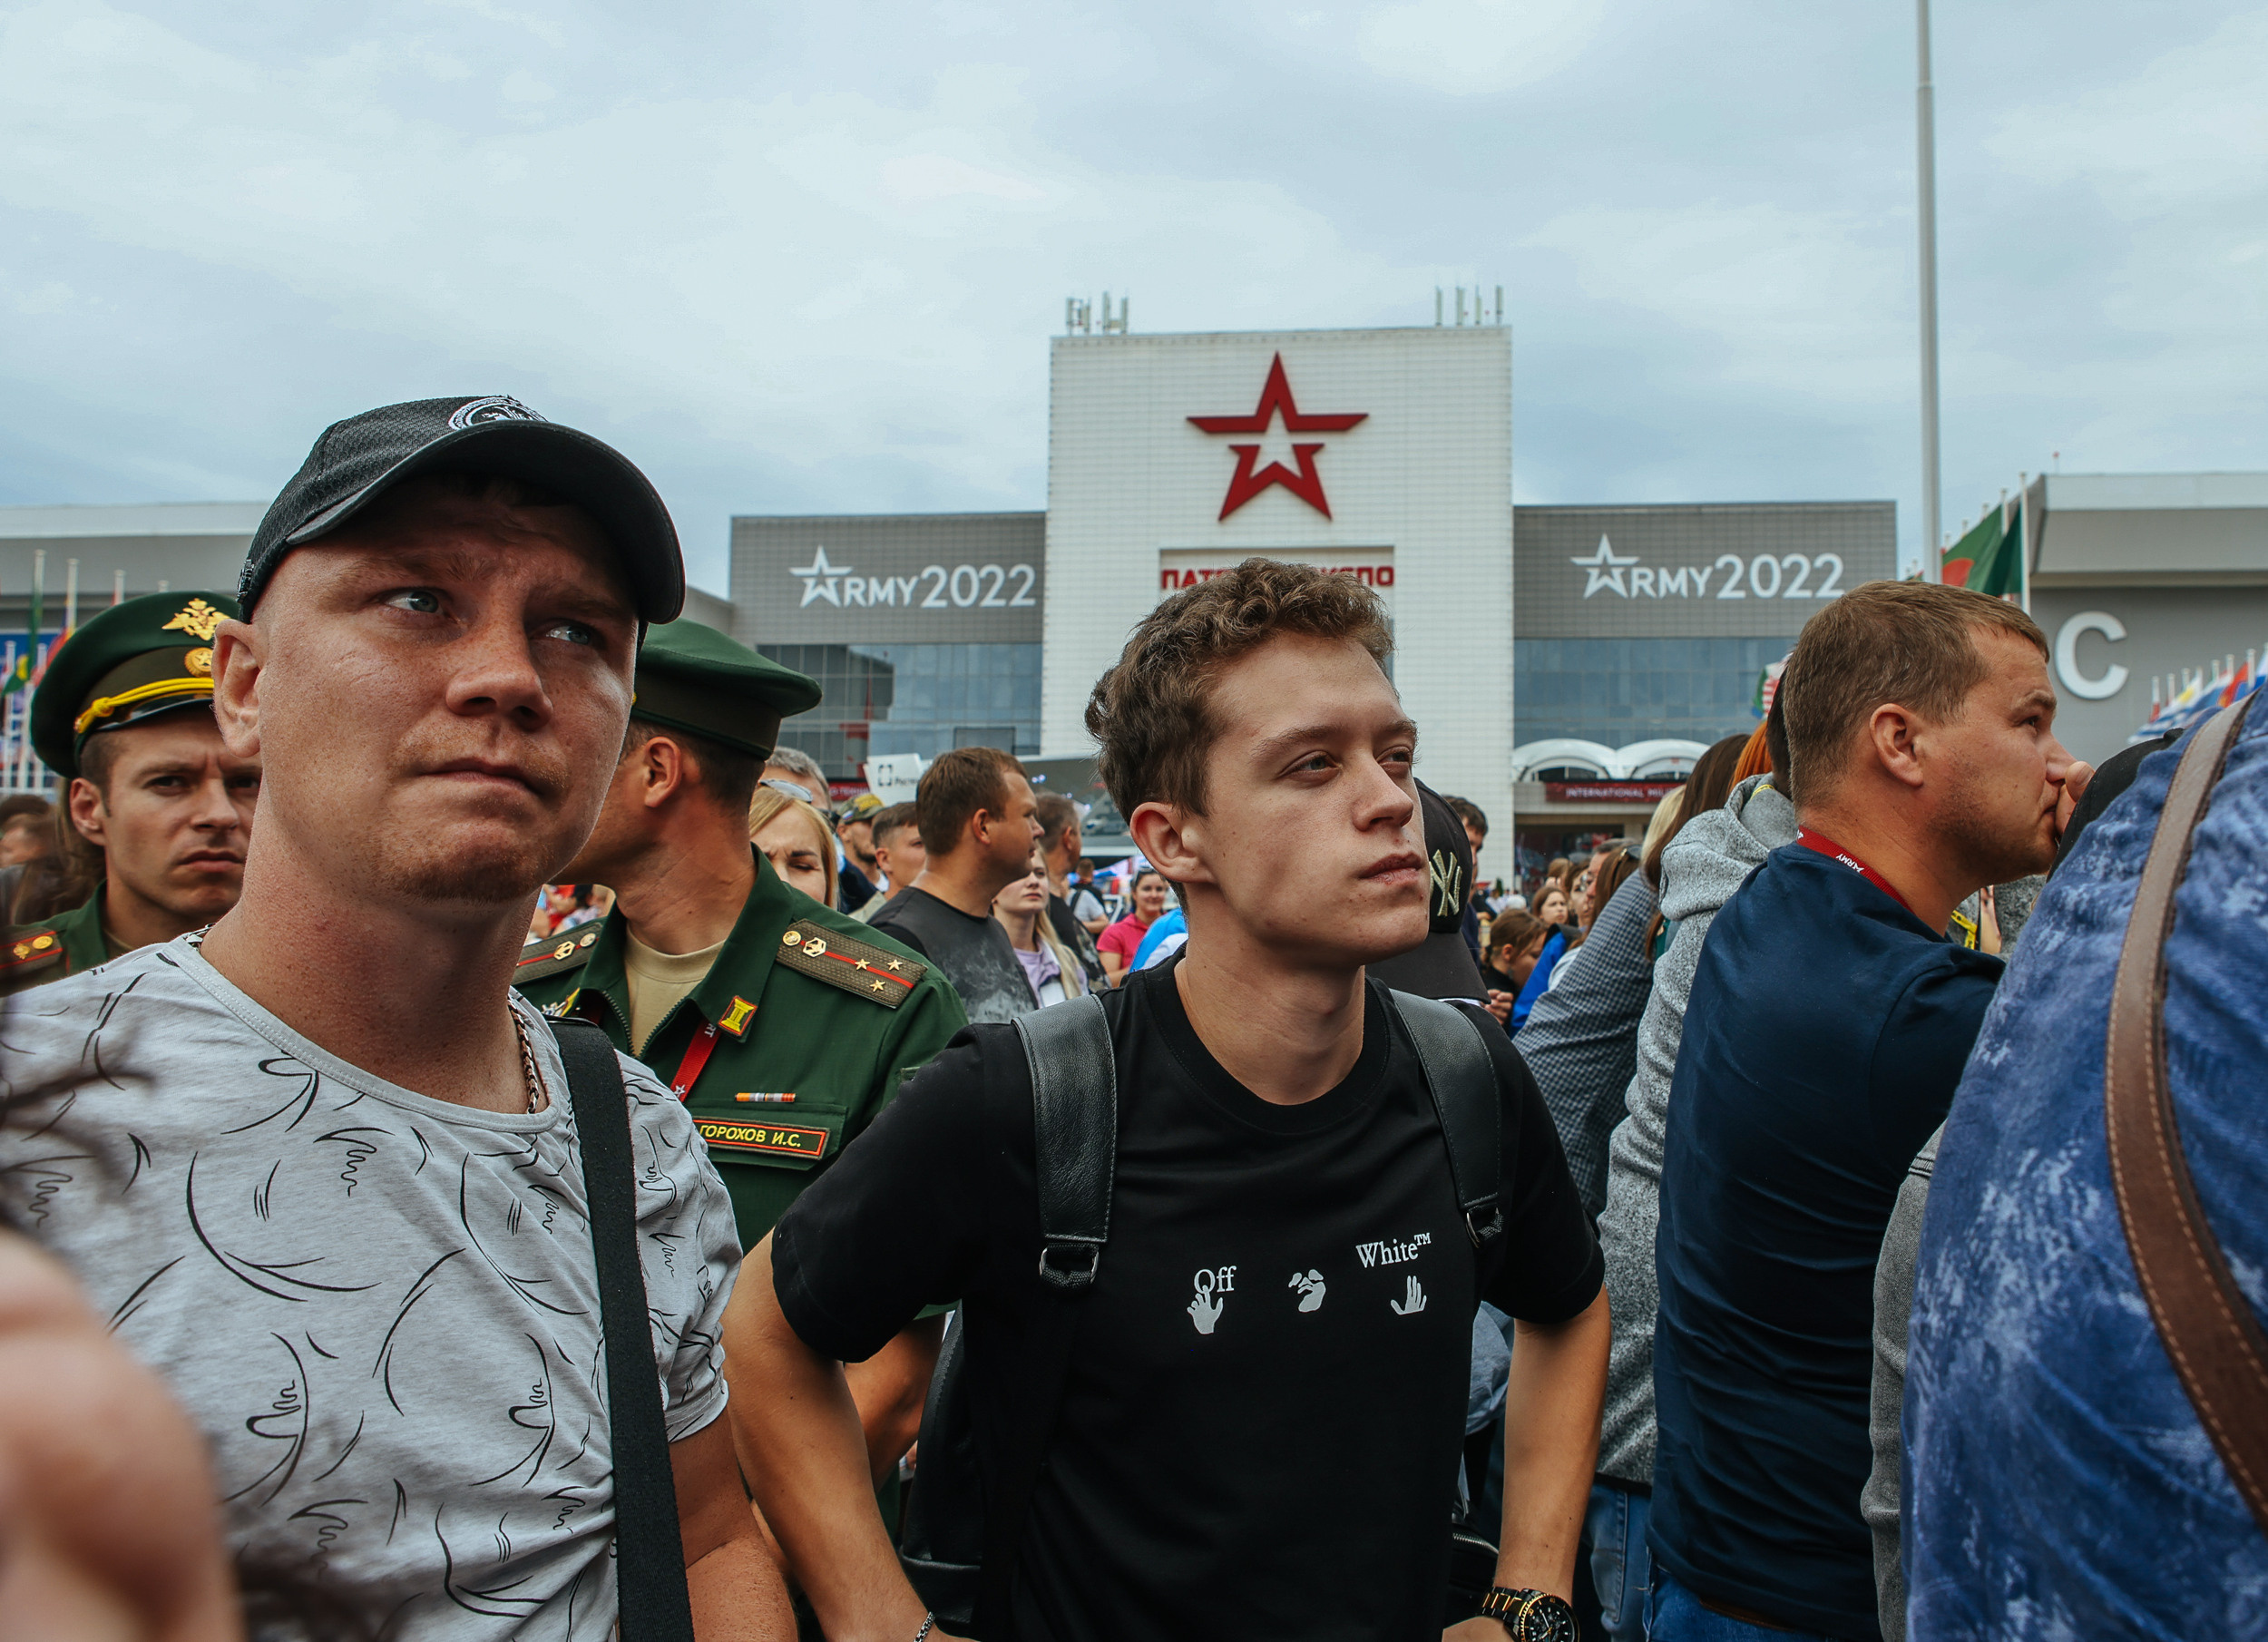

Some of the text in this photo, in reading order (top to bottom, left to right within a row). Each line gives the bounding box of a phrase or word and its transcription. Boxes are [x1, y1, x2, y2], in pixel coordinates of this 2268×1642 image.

[2054, 610, 2129, 700] C
[699, 1125, 801, 1148] ГОРОХОВ И.С.
[1193, 1266, 1237, 1295] Off
